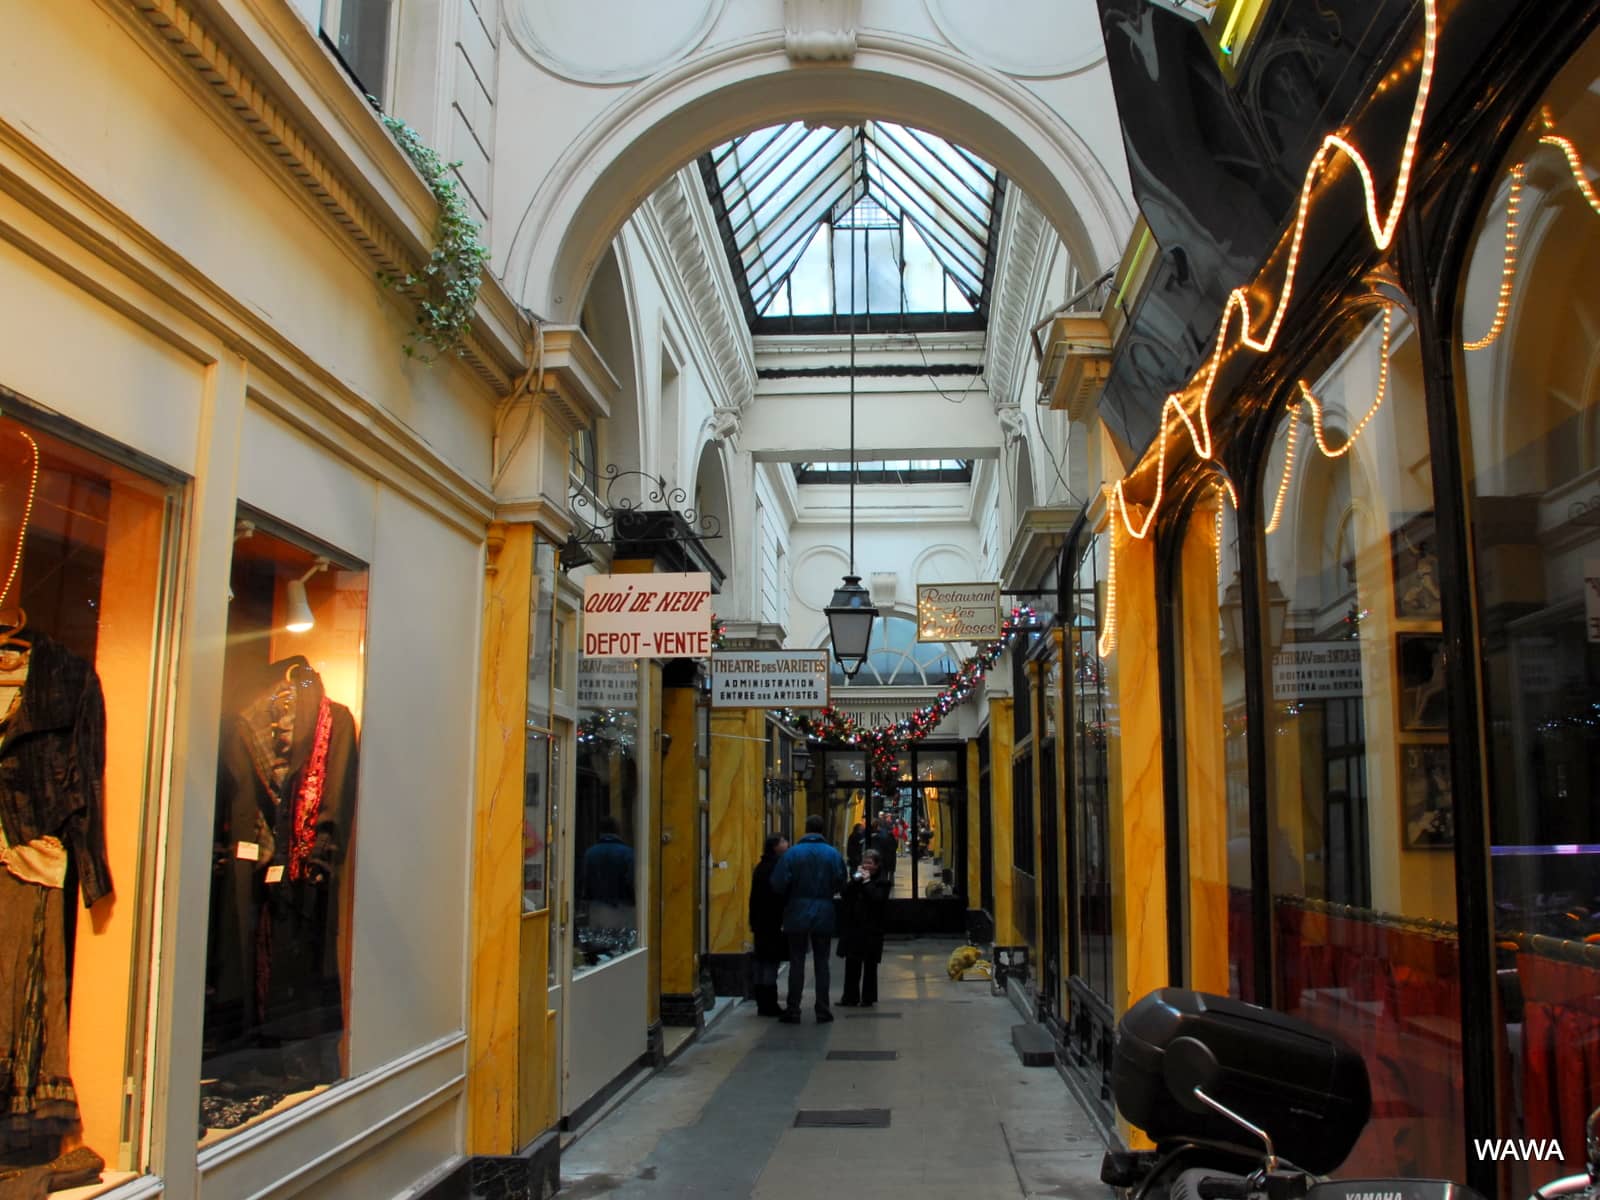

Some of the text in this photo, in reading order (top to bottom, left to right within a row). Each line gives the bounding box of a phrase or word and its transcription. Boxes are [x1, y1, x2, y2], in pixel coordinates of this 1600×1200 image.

[921, 587, 996, 603] Restaurant
[631, 592, 658, 613] DE
[655, 591, 710, 613] NEUF
[943, 605, 976, 618] Les
[761, 663, 776, 673] DES
[725, 679, 814, 688] ADMINISTRATION
[720, 691, 755, 700] ENTREE
[774, 690, 819, 700] ARTISTES
[1346, 1192, 1403, 1200] YAMAHA
